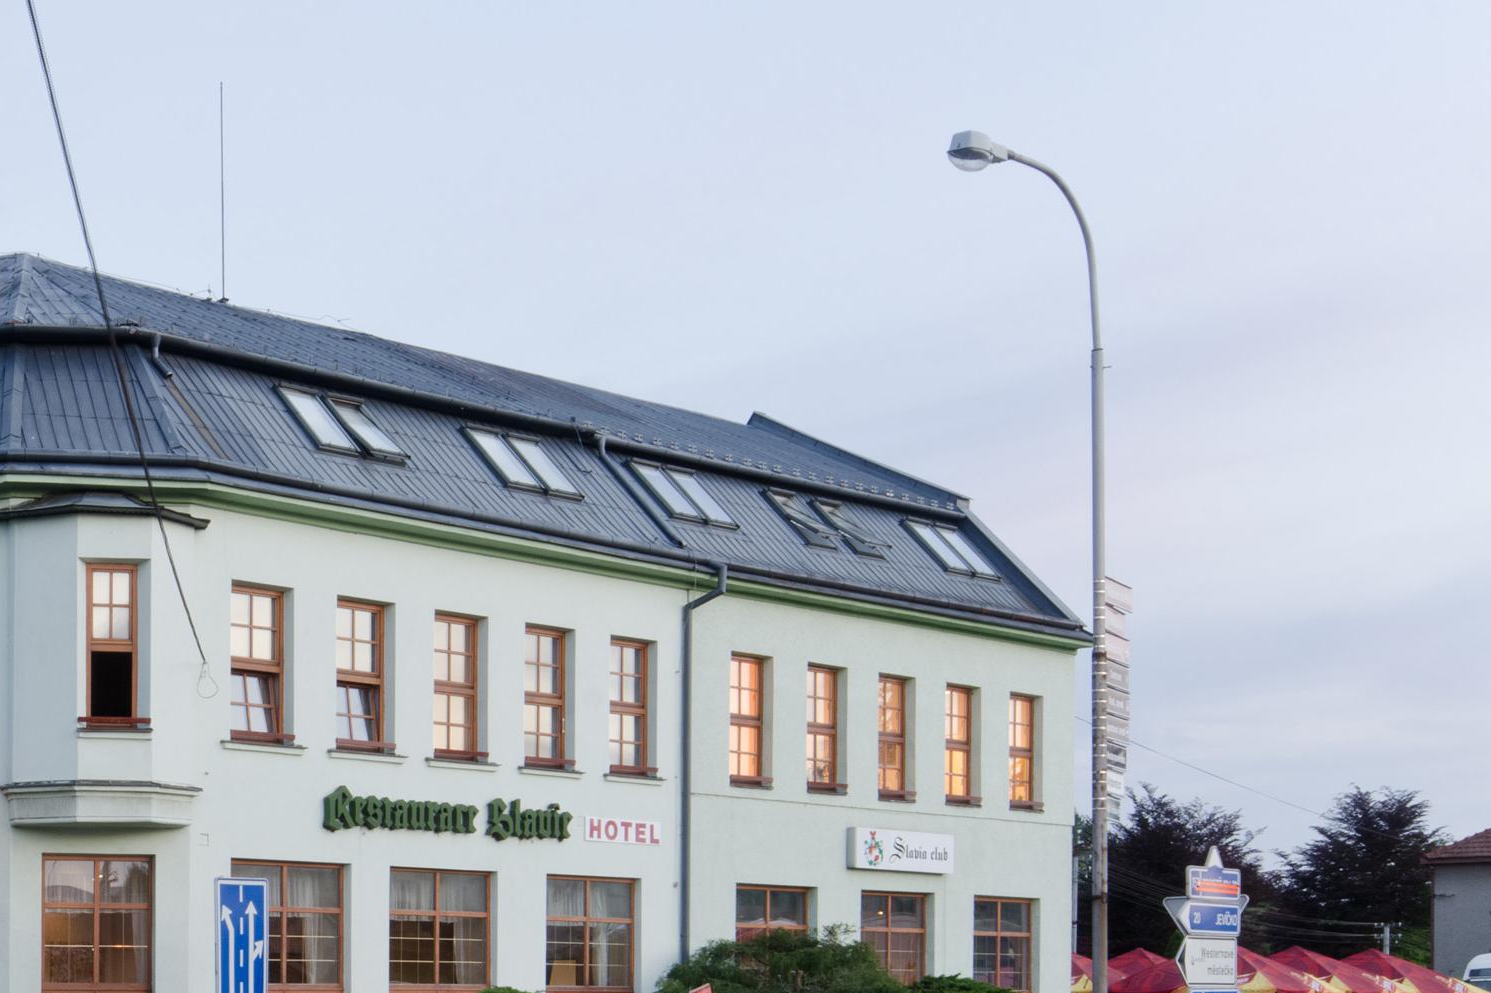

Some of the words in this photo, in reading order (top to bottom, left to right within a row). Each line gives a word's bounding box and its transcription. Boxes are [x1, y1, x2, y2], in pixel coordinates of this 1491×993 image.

[322, 785, 479, 834] Restaurace
[588, 818, 660, 844] HOTEL
[889, 836, 927, 864] Slavia
[930, 846, 948, 861] club
